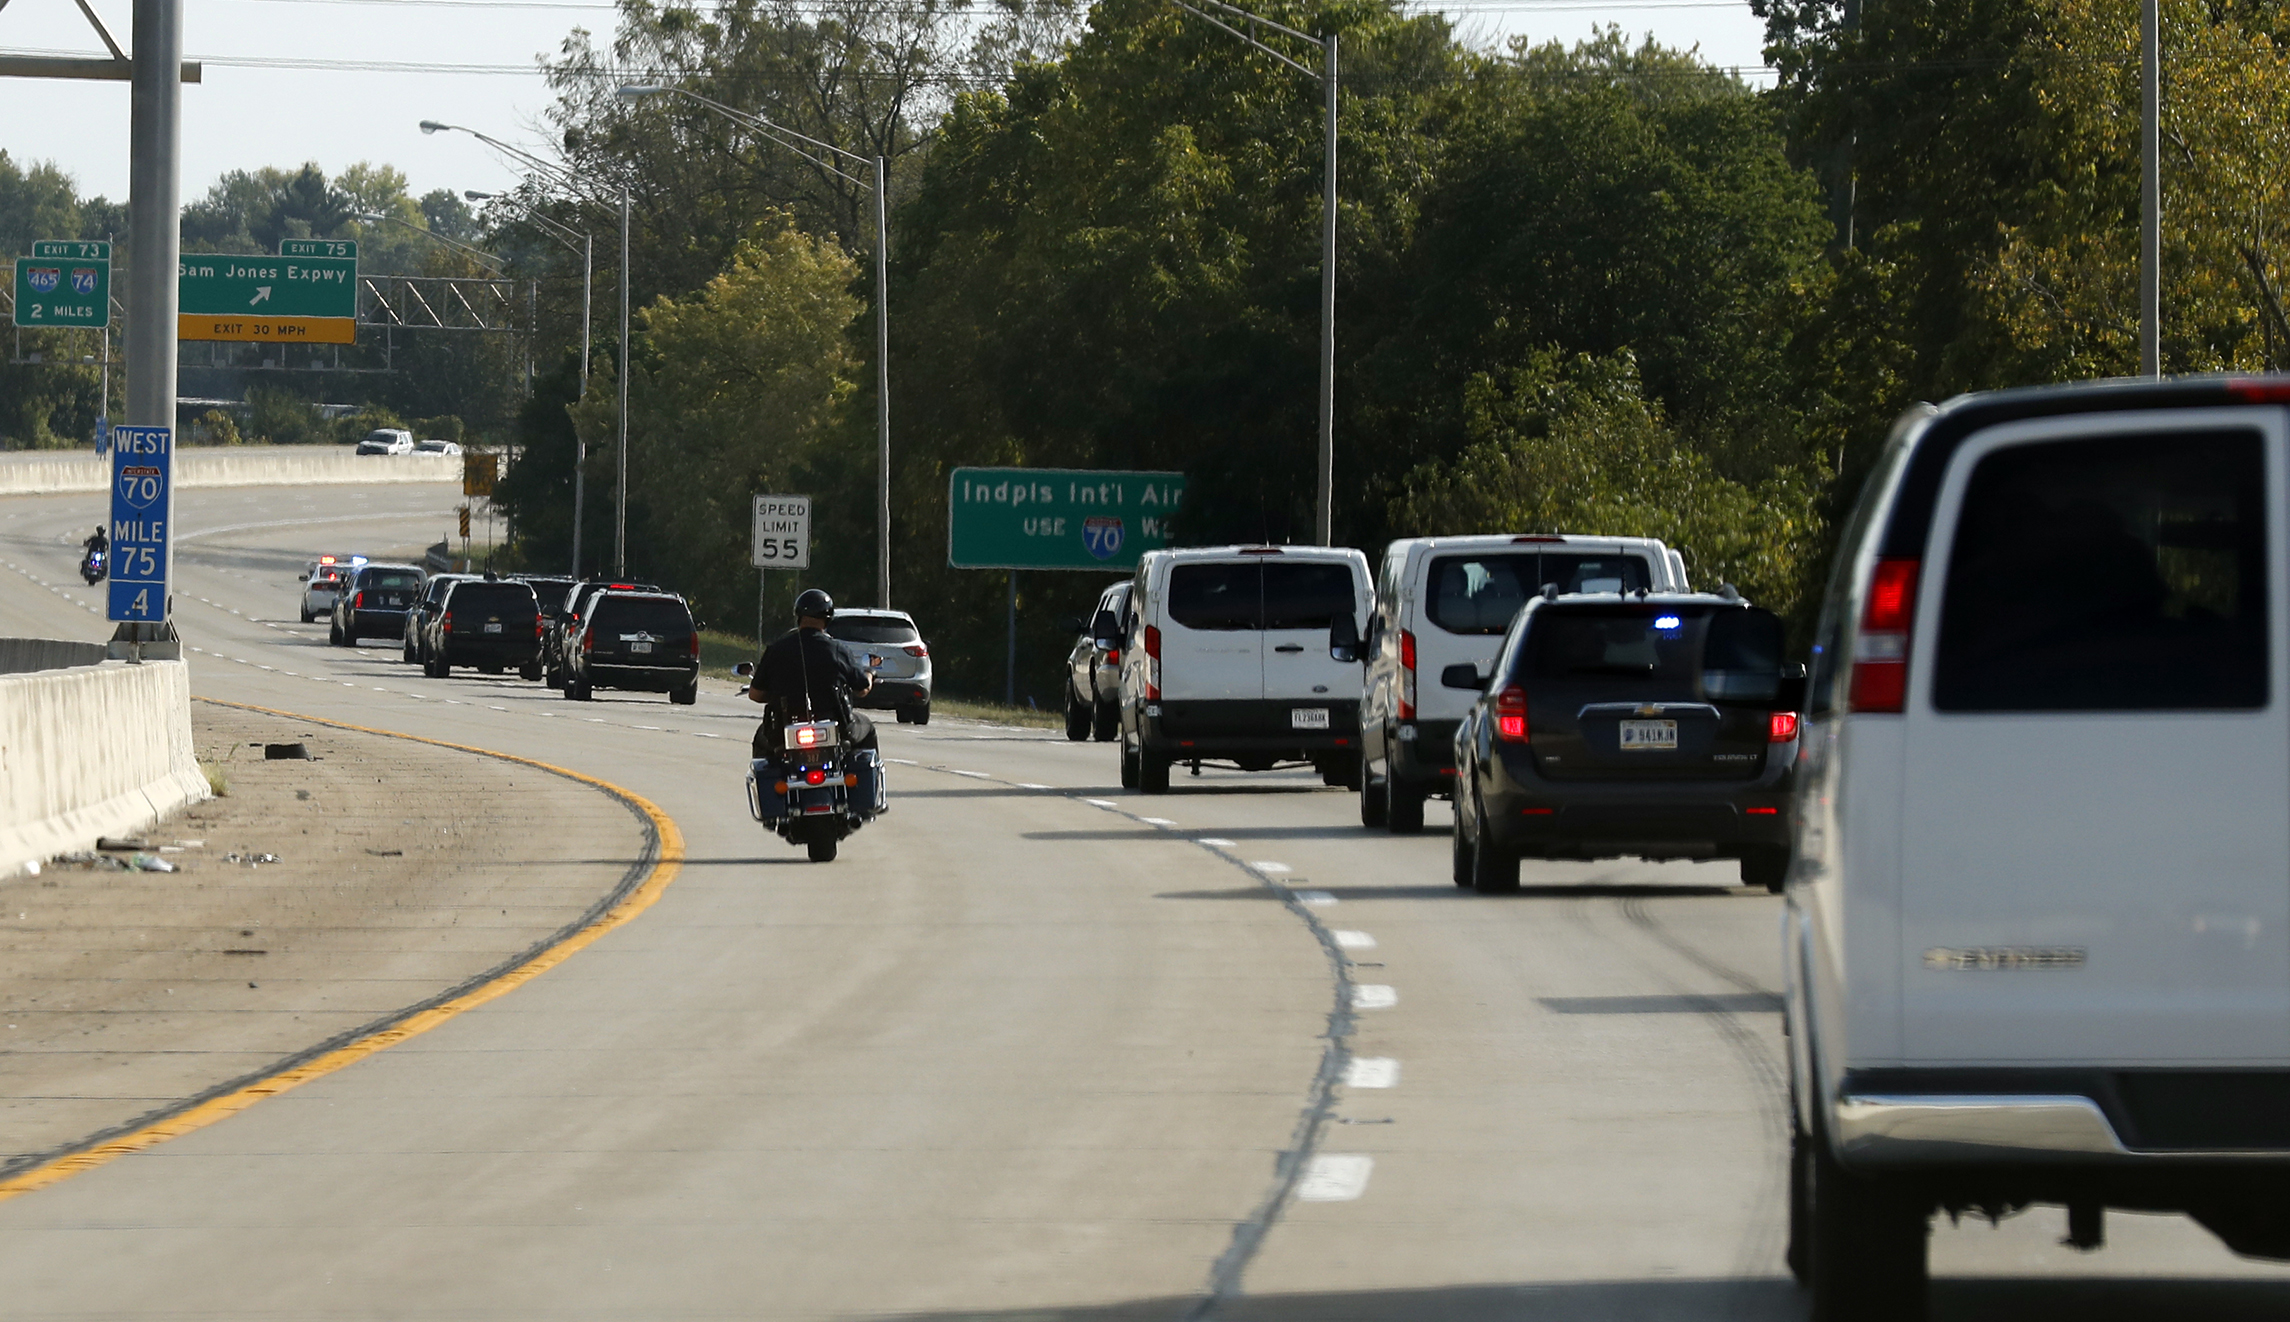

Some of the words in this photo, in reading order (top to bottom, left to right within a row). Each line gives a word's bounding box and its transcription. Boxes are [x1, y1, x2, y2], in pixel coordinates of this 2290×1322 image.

[44, 245, 69, 254] EXIT
[78, 243, 100, 257] 73
[291, 244, 316, 253] EXIT
[326, 243, 347, 256] 75
[30, 272, 58, 286] 465
[73, 273, 94, 289] 74
[179, 263, 214, 277] Sam
[225, 264, 278, 278] Jones
[287, 265, 346, 283] Expwy
[30, 303, 43, 318] 2
[54, 305, 93, 317] MILES
[214, 323, 243, 334] EXIT
[253, 324, 270, 335] 30
[277, 325, 306, 335] MPH
[115, 429, 169, 455] WEST
[123, 476, 157, 500] 70
[964, 479, 1053, 507] Indpls
[1069, 482, 1123, 505] Int'l
[758, 503, 806, 516] SPEED
[115, 520, 163, 543] MILE
[762, 521, 799, 533] LIMIT
[1024, 516, 1066, 536] USE
[1086, 526, 1120, 552] 70
[762, 538, 799, 560] 55
[121, 547, 156, 576] 75
[124, 588, 149, 616] .4
